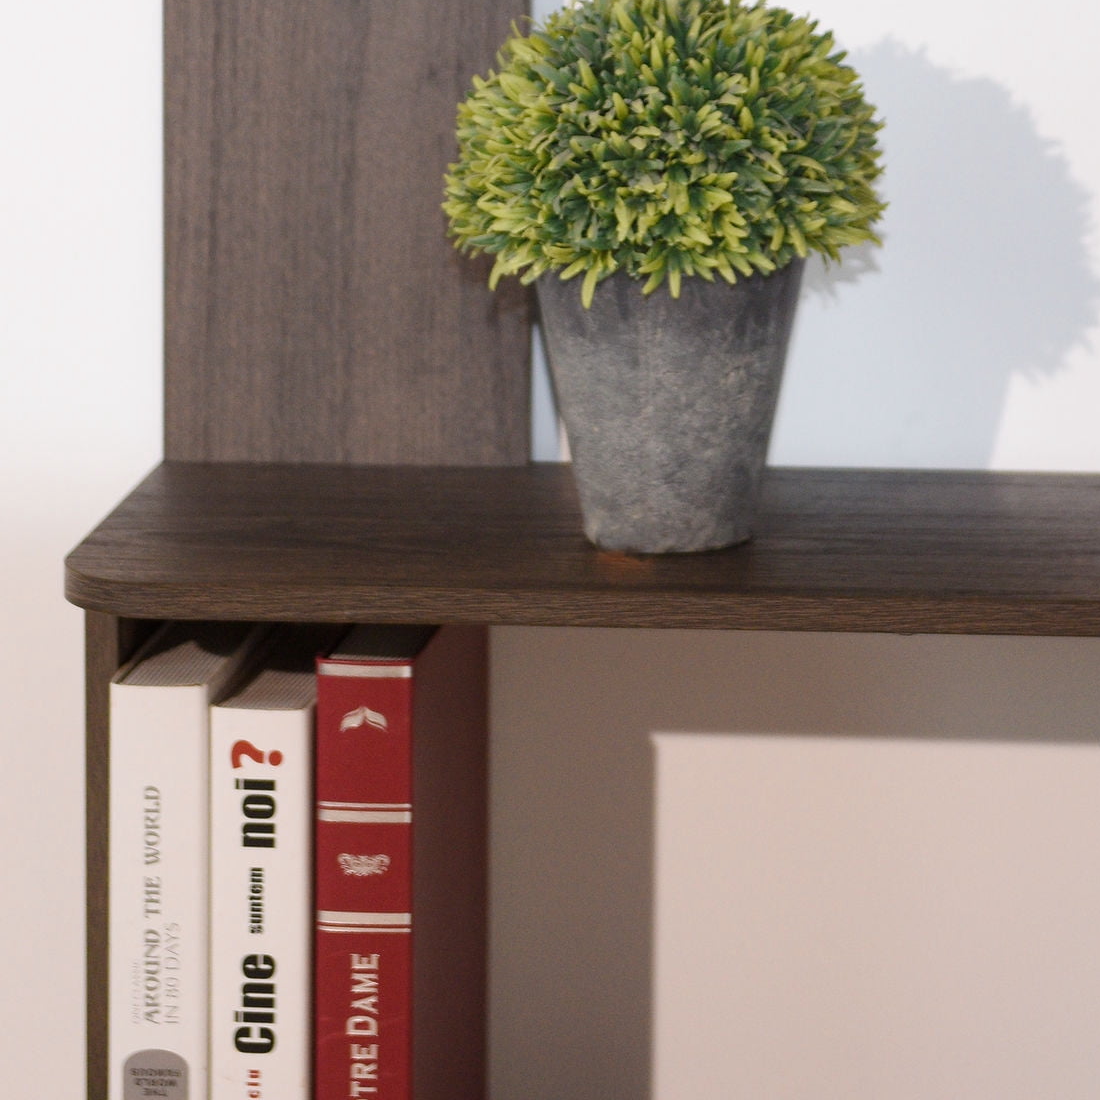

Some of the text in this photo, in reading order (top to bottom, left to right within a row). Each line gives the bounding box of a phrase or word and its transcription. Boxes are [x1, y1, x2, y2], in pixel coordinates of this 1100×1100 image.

[143, 785, 161, 1025] AROUND THE WORLD
[248, 867, 265, 934] suntem
[163, 922, 181, 970] DAYS
[164, 1004, 181, 1024] IN
[234, 953, 277, 1055] Cine
[346, 953, 380, 1100] TRE DAME
